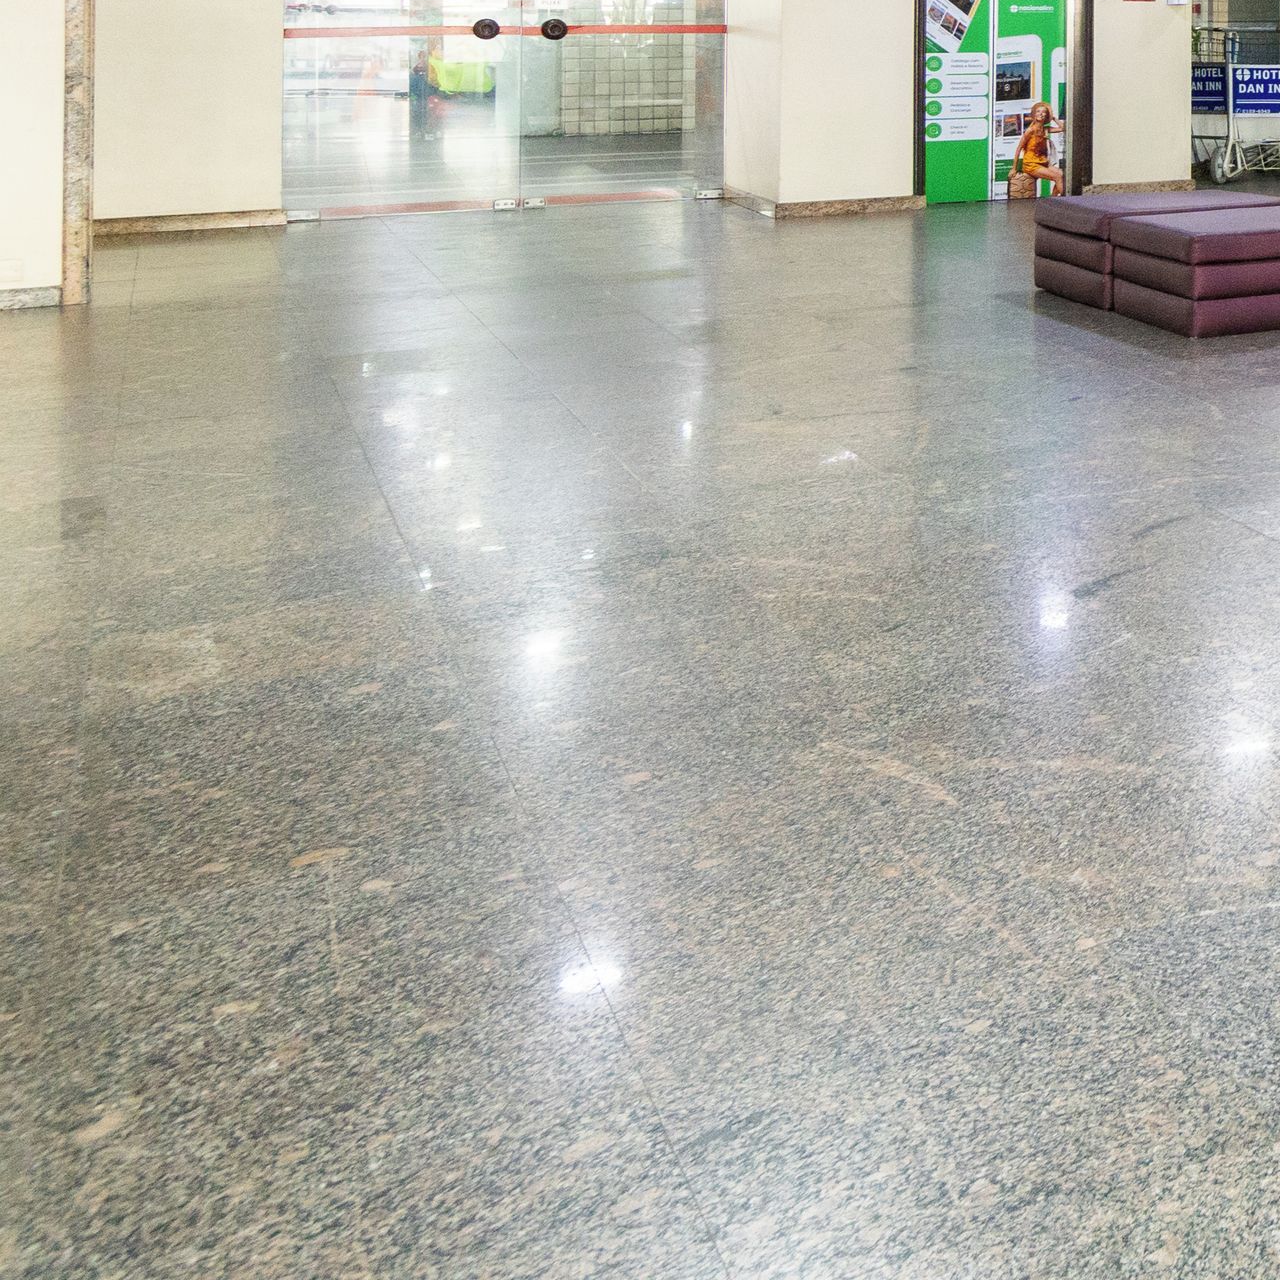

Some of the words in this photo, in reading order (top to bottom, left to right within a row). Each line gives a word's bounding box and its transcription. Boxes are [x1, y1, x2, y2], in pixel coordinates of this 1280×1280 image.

[1194, 68, 1224, 78] HOTEL
[1205, 81, 1222, 91] INN
[1239, 83, 1264, 93] DAN
